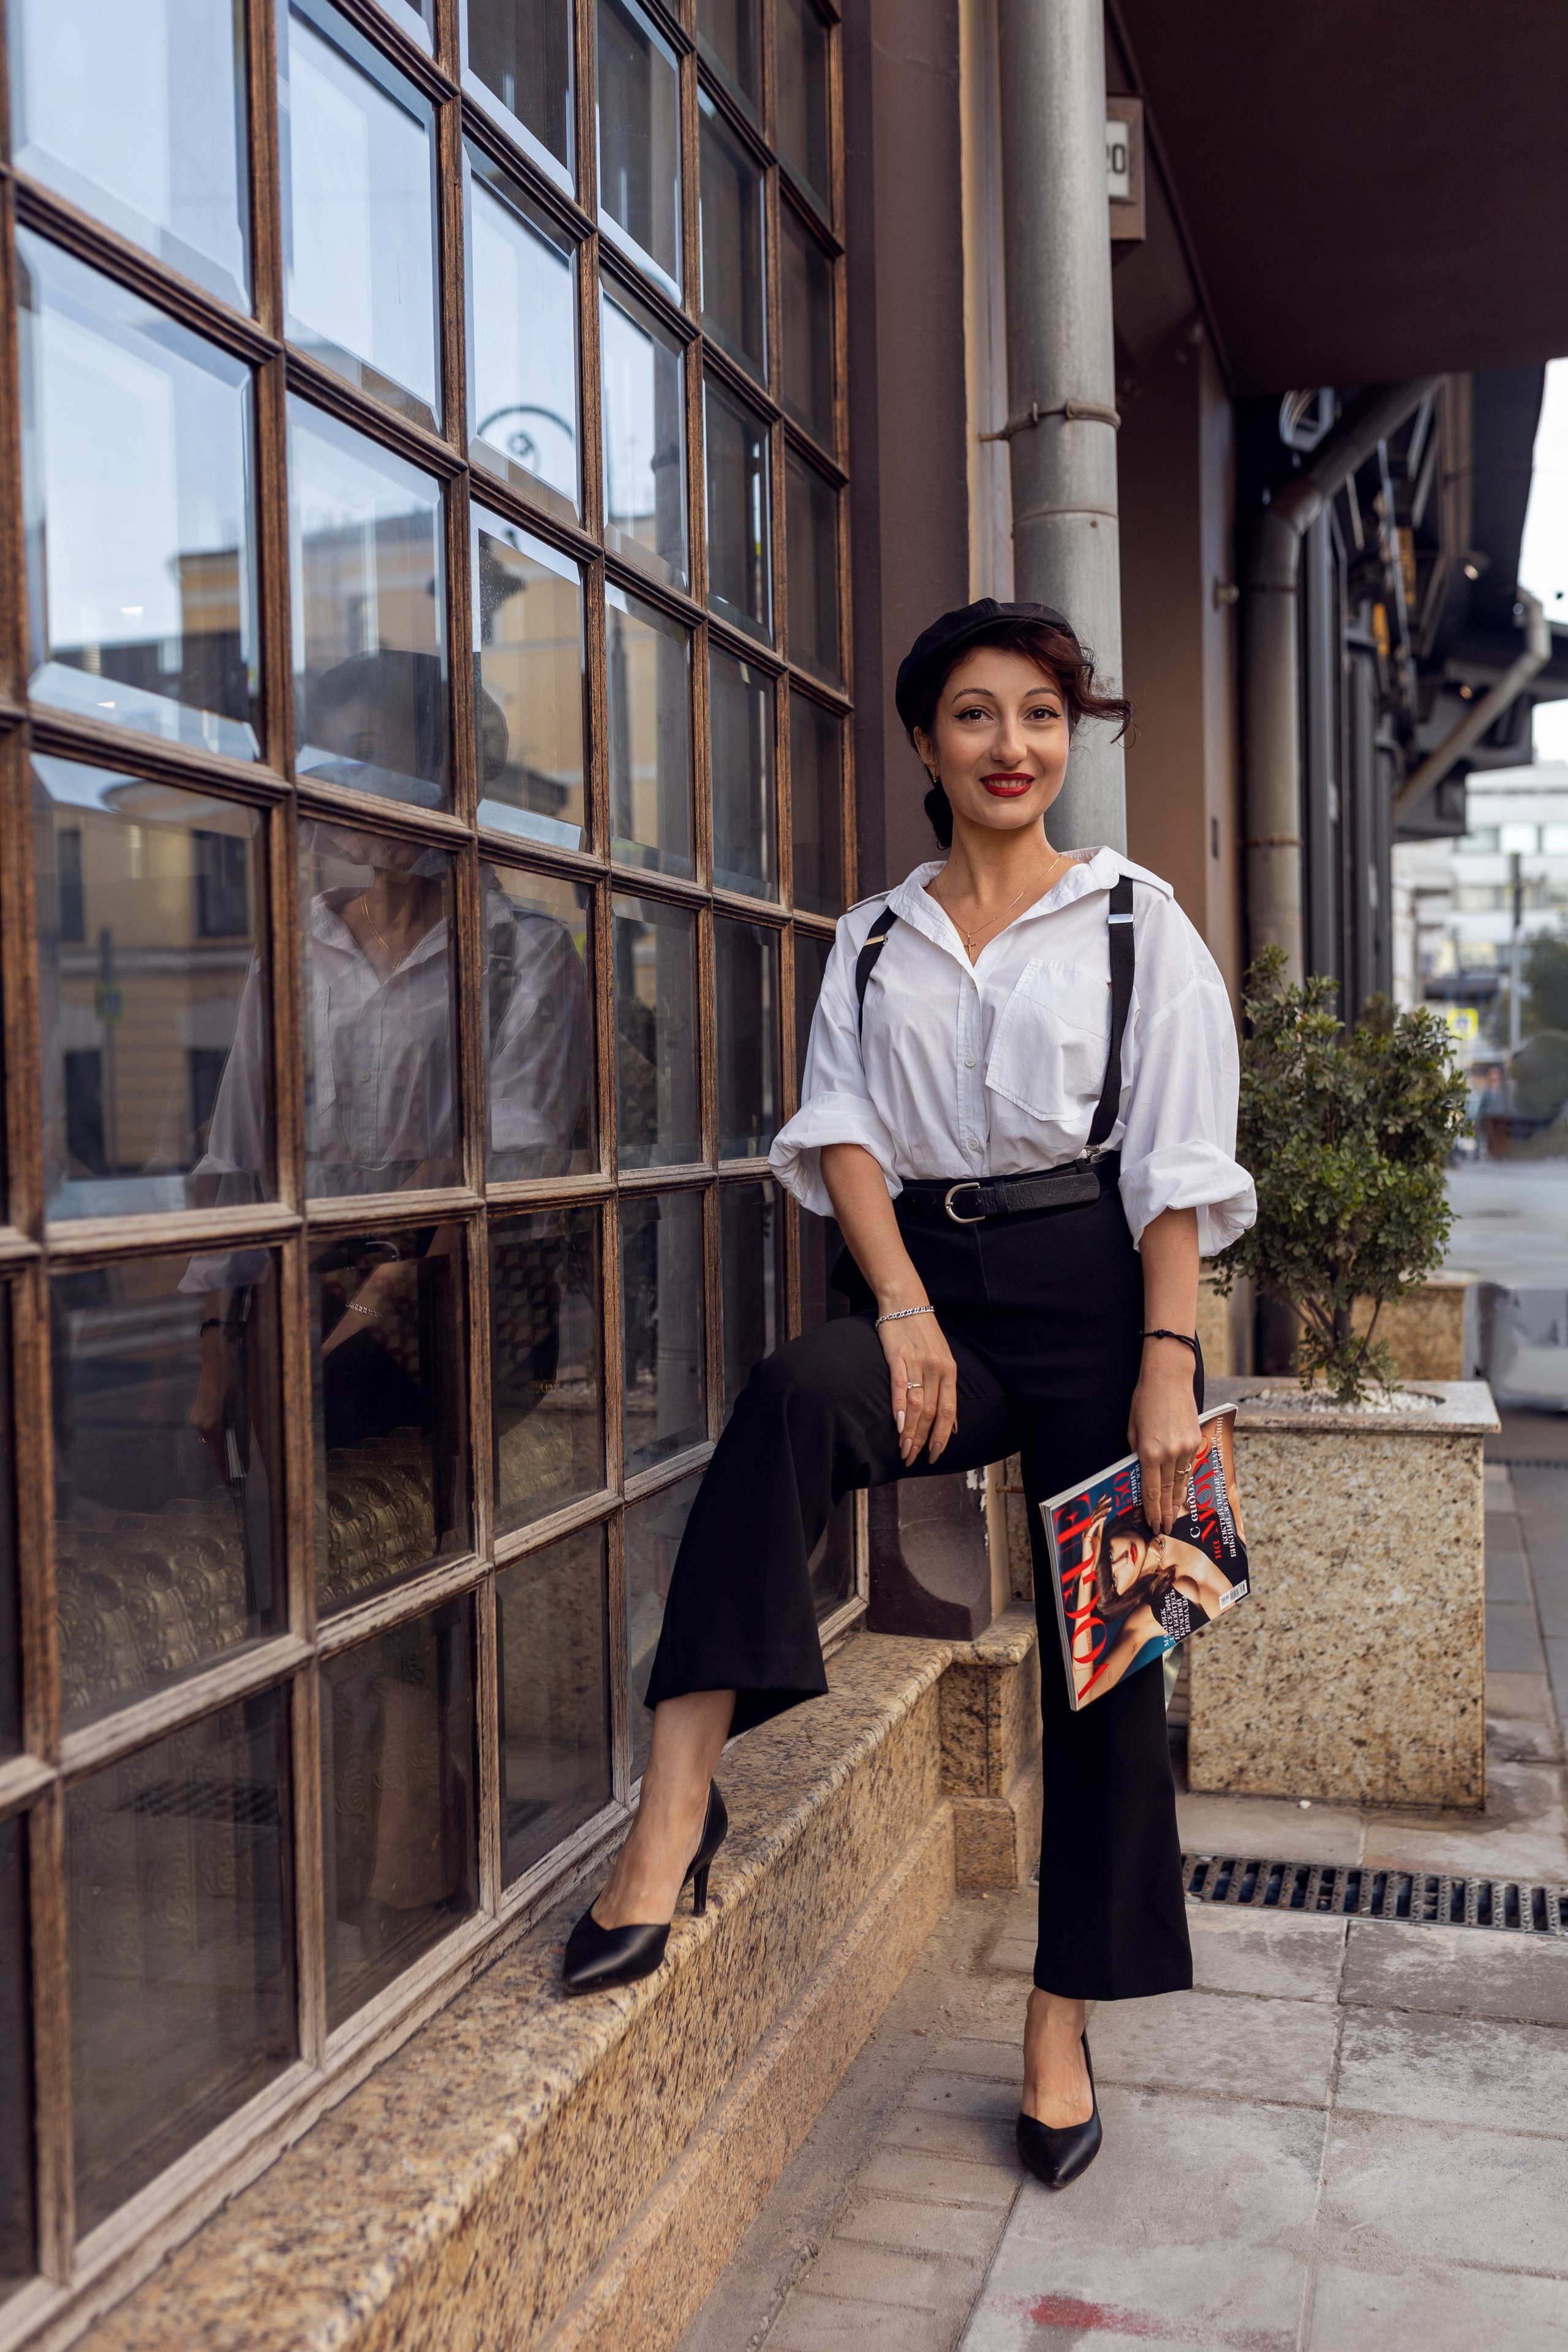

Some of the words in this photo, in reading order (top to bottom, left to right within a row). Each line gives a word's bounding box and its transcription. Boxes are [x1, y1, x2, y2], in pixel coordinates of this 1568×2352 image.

[1107, 144, 1126, 174] 0
[1114, 1471, 1133, 1516] 150
[1214, 1474, 1229, 1545] КОКТЕЙЛЬНЫЕ
[1190, 1526, 1200, 1538] С
[1213, 1540, 1222, 1559] на
[1054, 1493, 1109, 1702] VOGUE
[1170, 1589, 1178, 1627] БОЙТЕСЬ
[1160, 1608, 1169, 1646] МАКИЯЖ
[1174, 1627, 1180, 1640] НЕ
[1176, 1598, 1186, 1636] КРАСНОЙ
